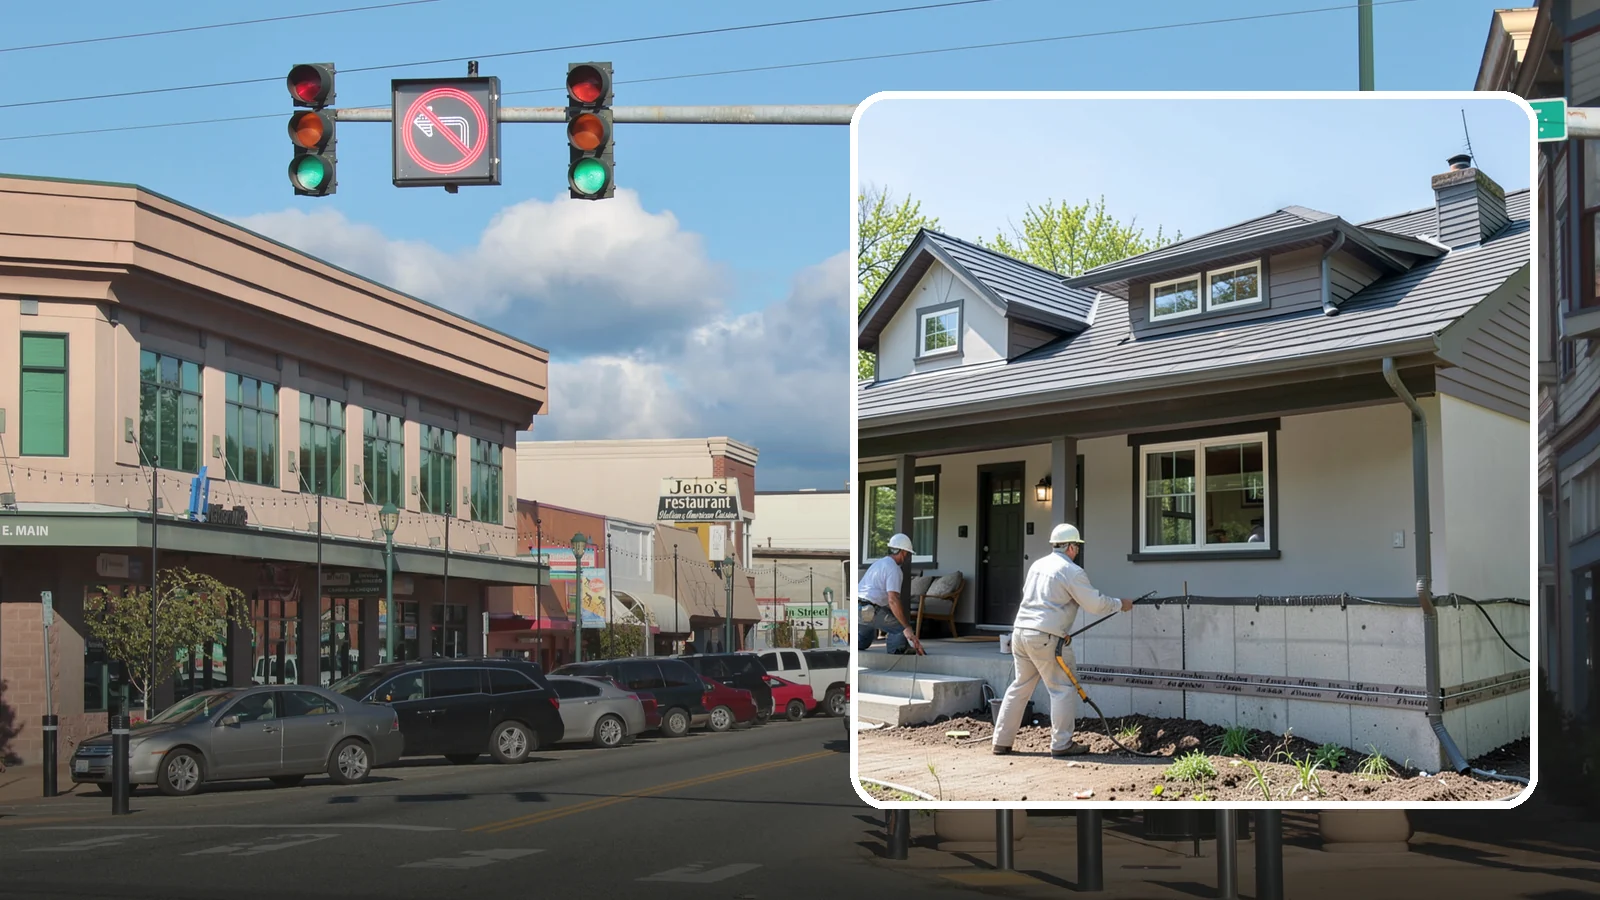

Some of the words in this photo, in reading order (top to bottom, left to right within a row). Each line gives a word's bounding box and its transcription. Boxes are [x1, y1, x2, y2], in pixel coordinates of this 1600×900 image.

[669, 480, 728, 495] Jeno's
[665, 496, 731, 509] restaurant
[659, 510, 681, 520] Italian
[686, 509, 714, 519] American
[715, 509, 737, 519] Cuisine
[2, 525, 13, 536] E.
[15, 525, 49, 536] MAIN
[785, 607, 795, 617] in
[797, 607, 828, 617] Street
[791, 619, 824, 627] lass
